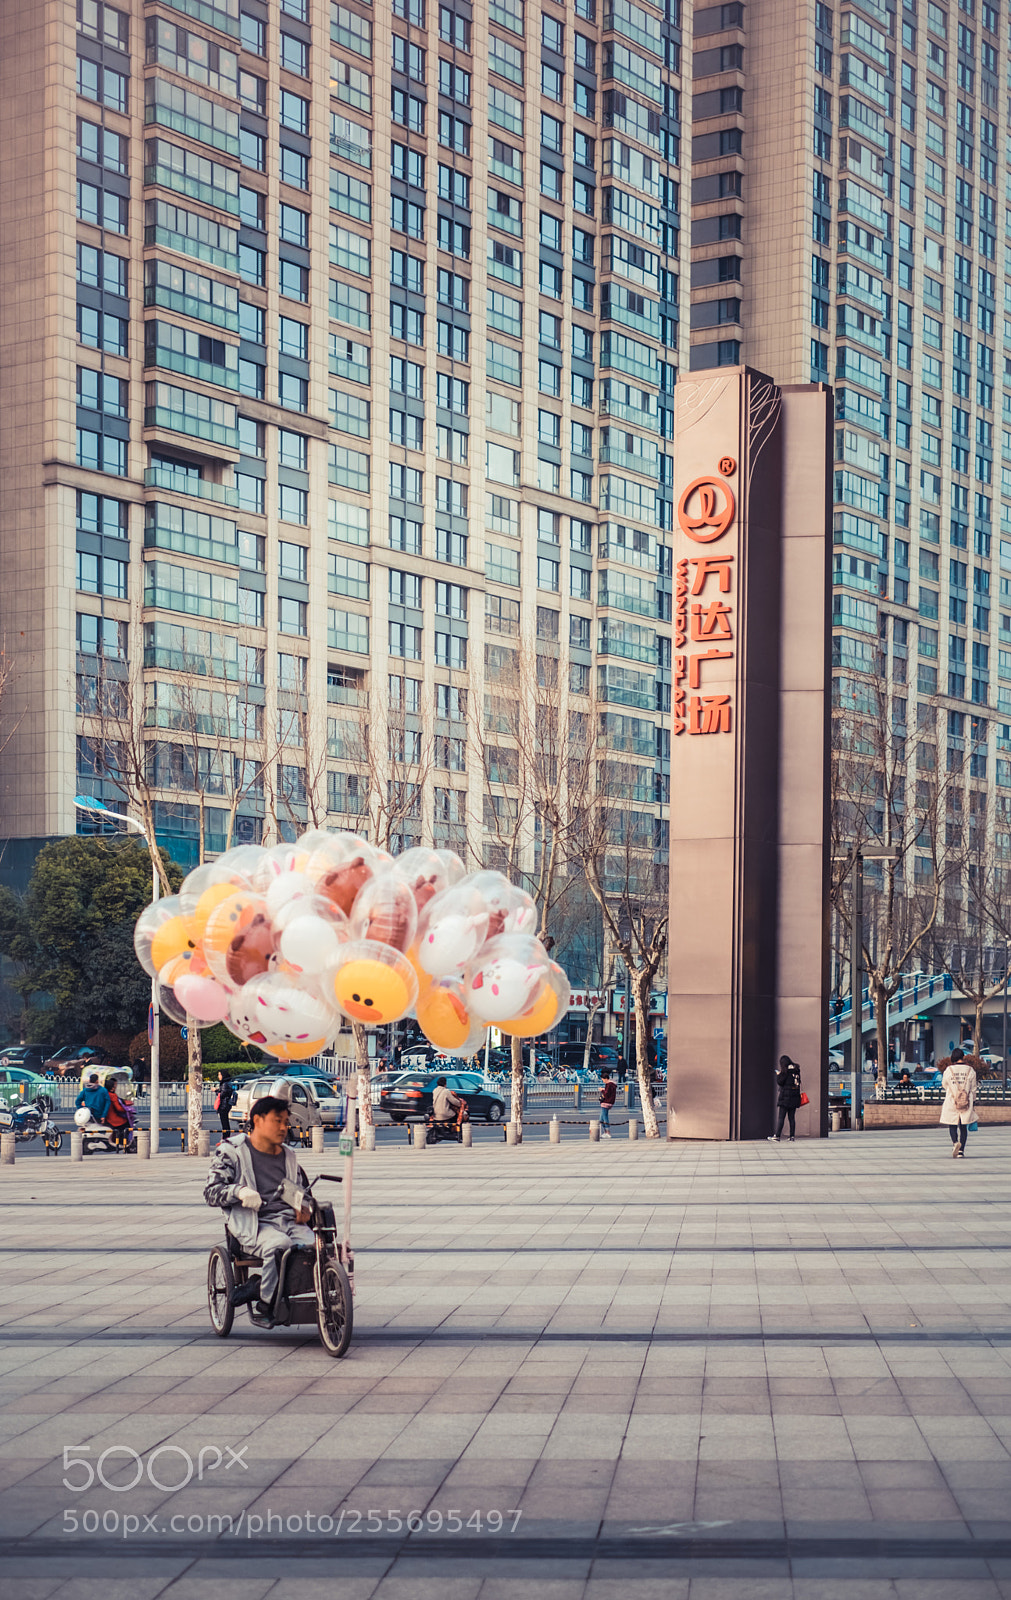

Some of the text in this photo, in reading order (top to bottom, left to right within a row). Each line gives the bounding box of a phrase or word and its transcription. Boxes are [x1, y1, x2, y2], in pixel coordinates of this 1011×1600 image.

[673, 558, 688, 736] WANDA PLAZA
[687, 555, 734, 735] 万达广场
